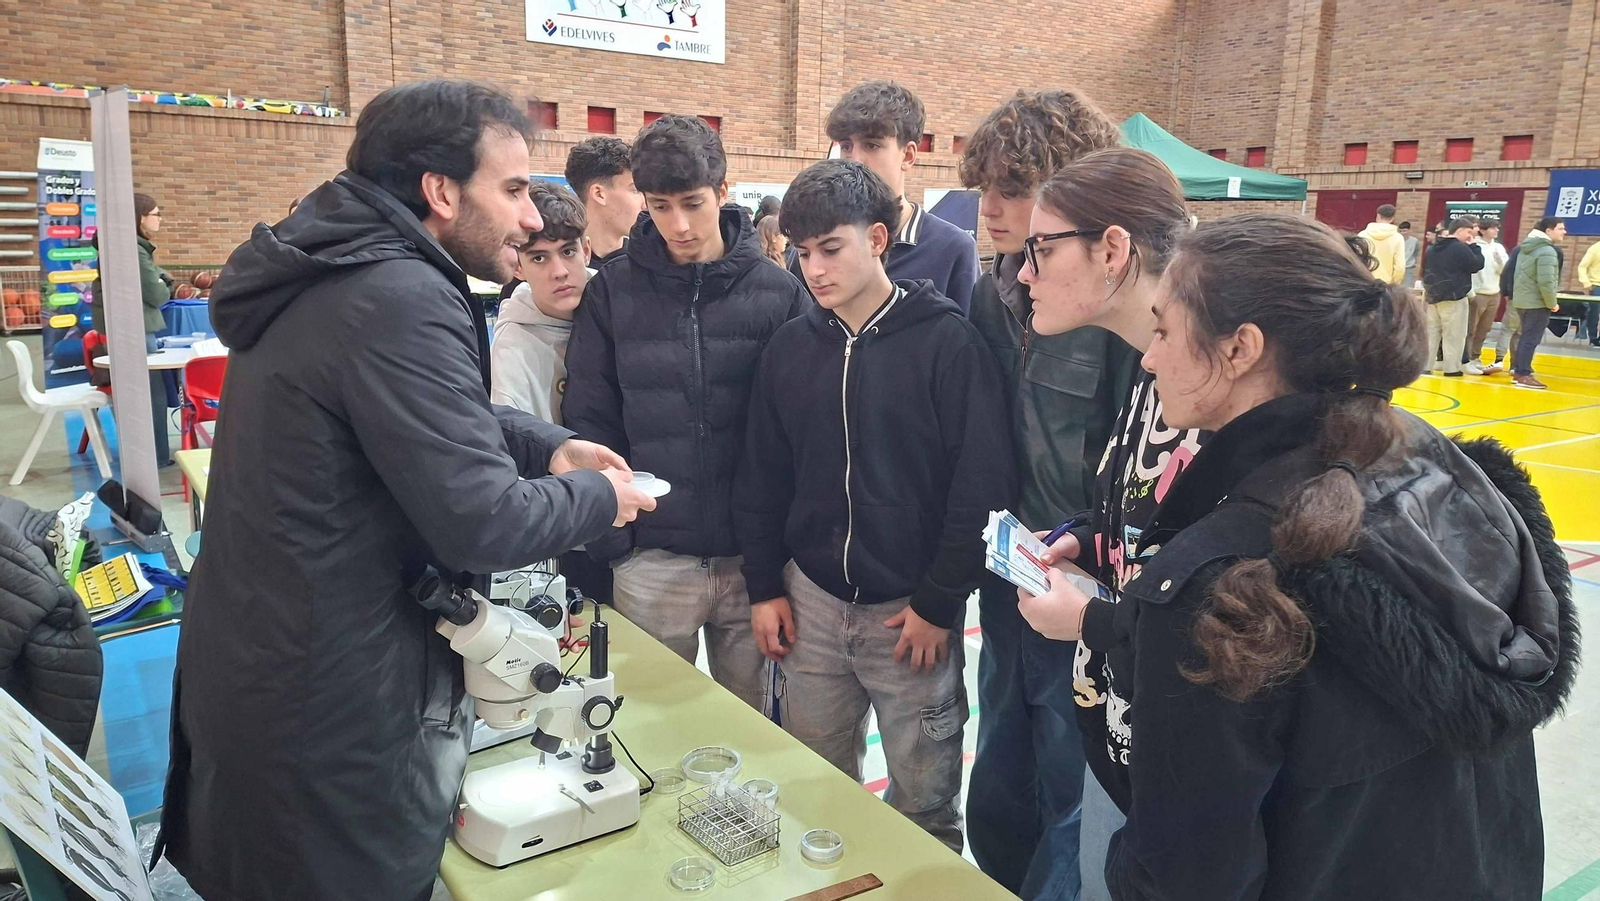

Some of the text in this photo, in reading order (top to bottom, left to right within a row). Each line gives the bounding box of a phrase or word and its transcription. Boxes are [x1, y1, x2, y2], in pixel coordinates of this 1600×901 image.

[561, 26, 615, 43] EDELVIVES
[675, 40, 712, 55] TAMBRE
[50, 148, 76, 157] Deusto
[46, 175, 81, 187] Grados y
[45, 186, 74, 195] Dobles
